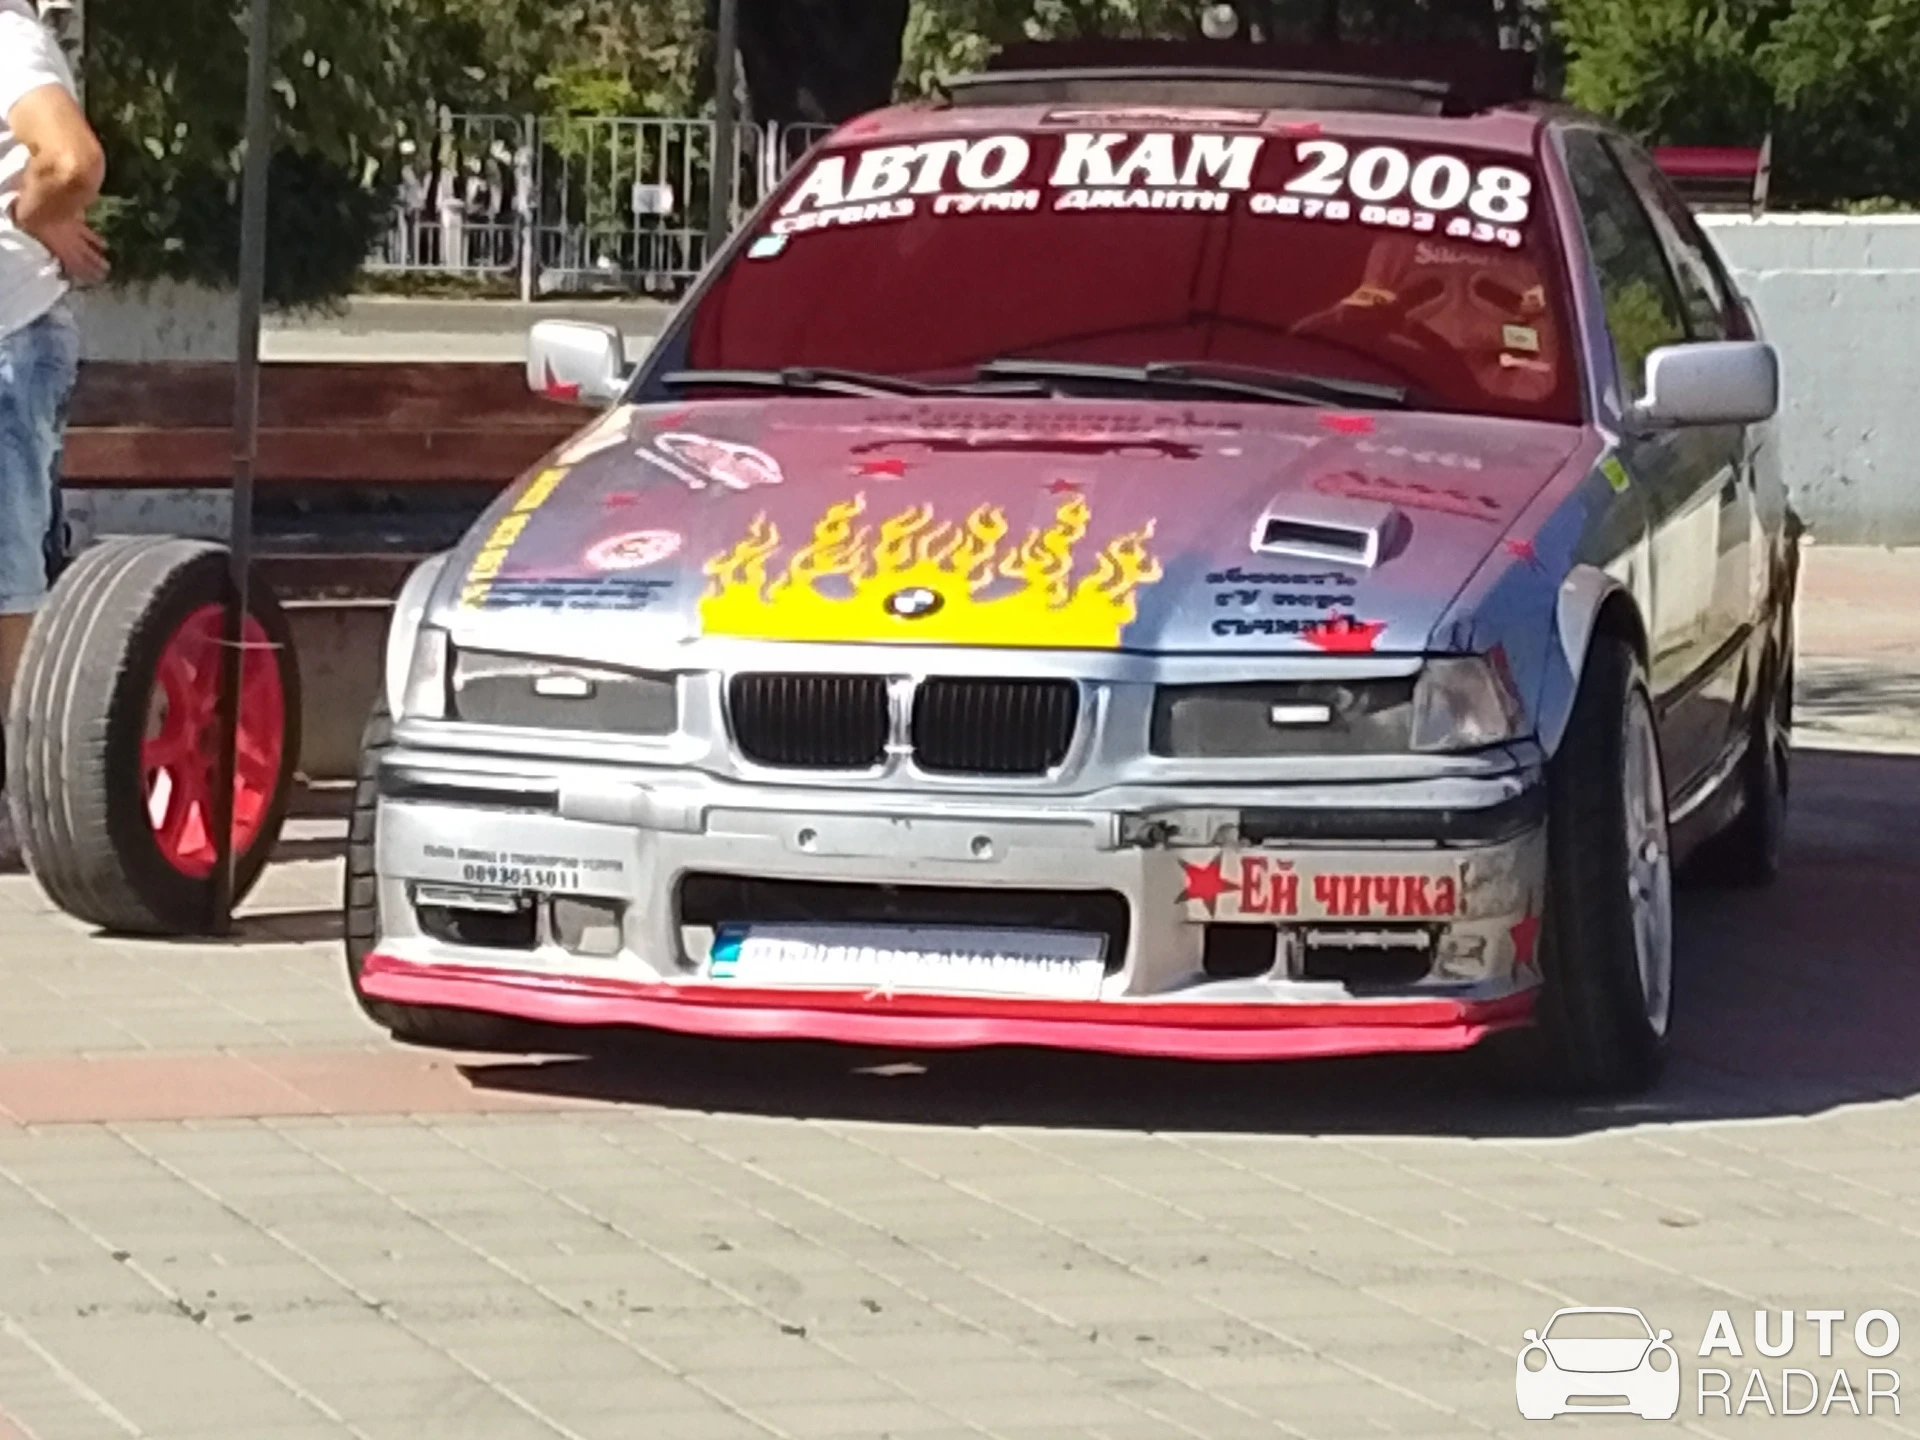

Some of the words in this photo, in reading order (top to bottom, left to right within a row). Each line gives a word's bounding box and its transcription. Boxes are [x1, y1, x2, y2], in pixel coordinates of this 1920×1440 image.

[782, 135, 1030, 214] АВТО
[1049, 133, 1265, 191] КАМ
[1284, 140, 1532, 225] 2008
[1238, 856, 1298, 915] Ей
